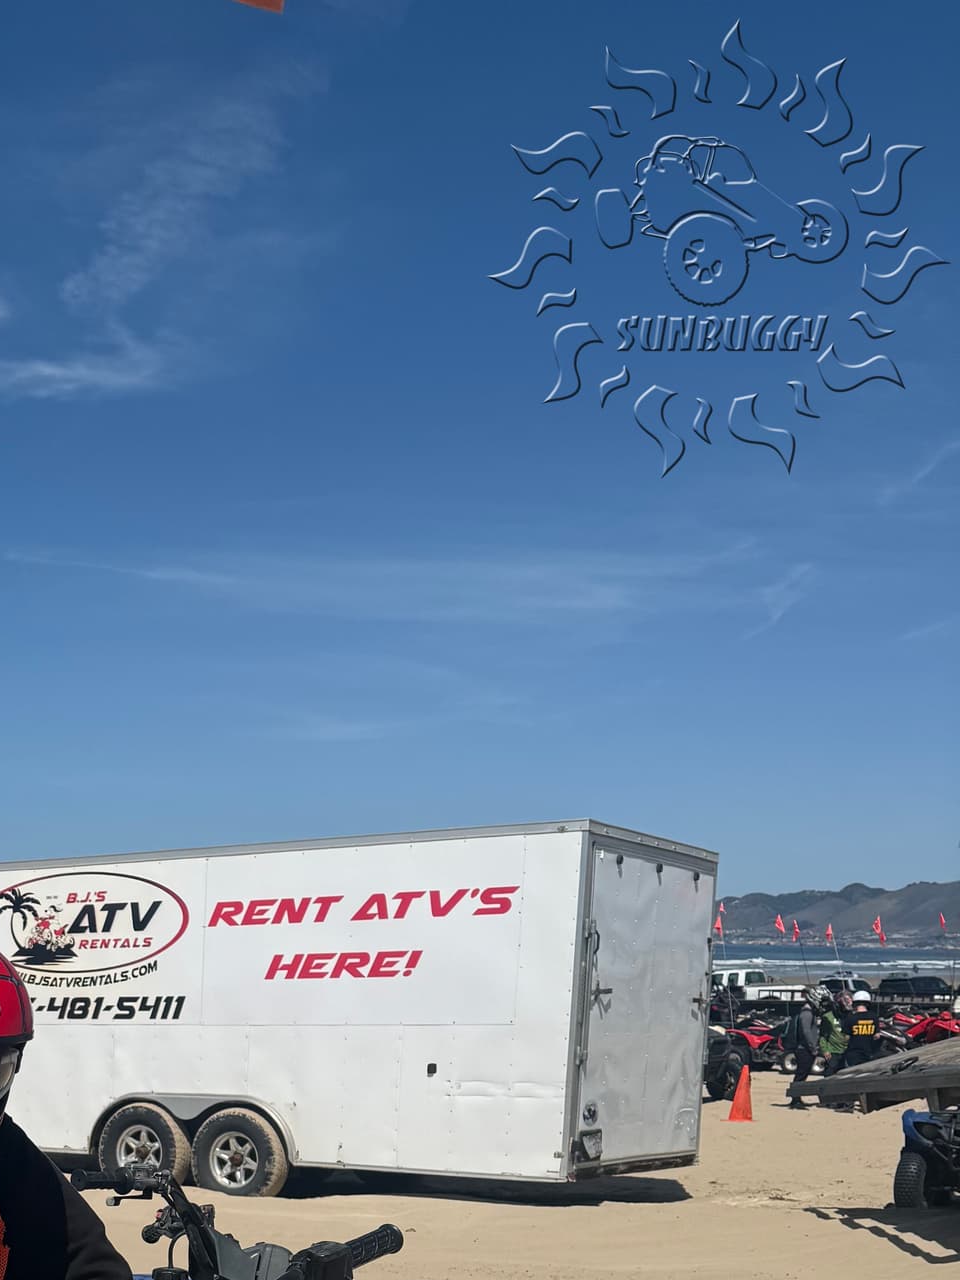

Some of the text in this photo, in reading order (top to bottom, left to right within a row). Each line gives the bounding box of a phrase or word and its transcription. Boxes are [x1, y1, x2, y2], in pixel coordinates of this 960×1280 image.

[67, 900, 163, 935] ATV
[207, 886, 521, 928] RENT ATV'S
[78, 937, 154, 950] RENTALS
[263, 950, 424, 981] HERE!
